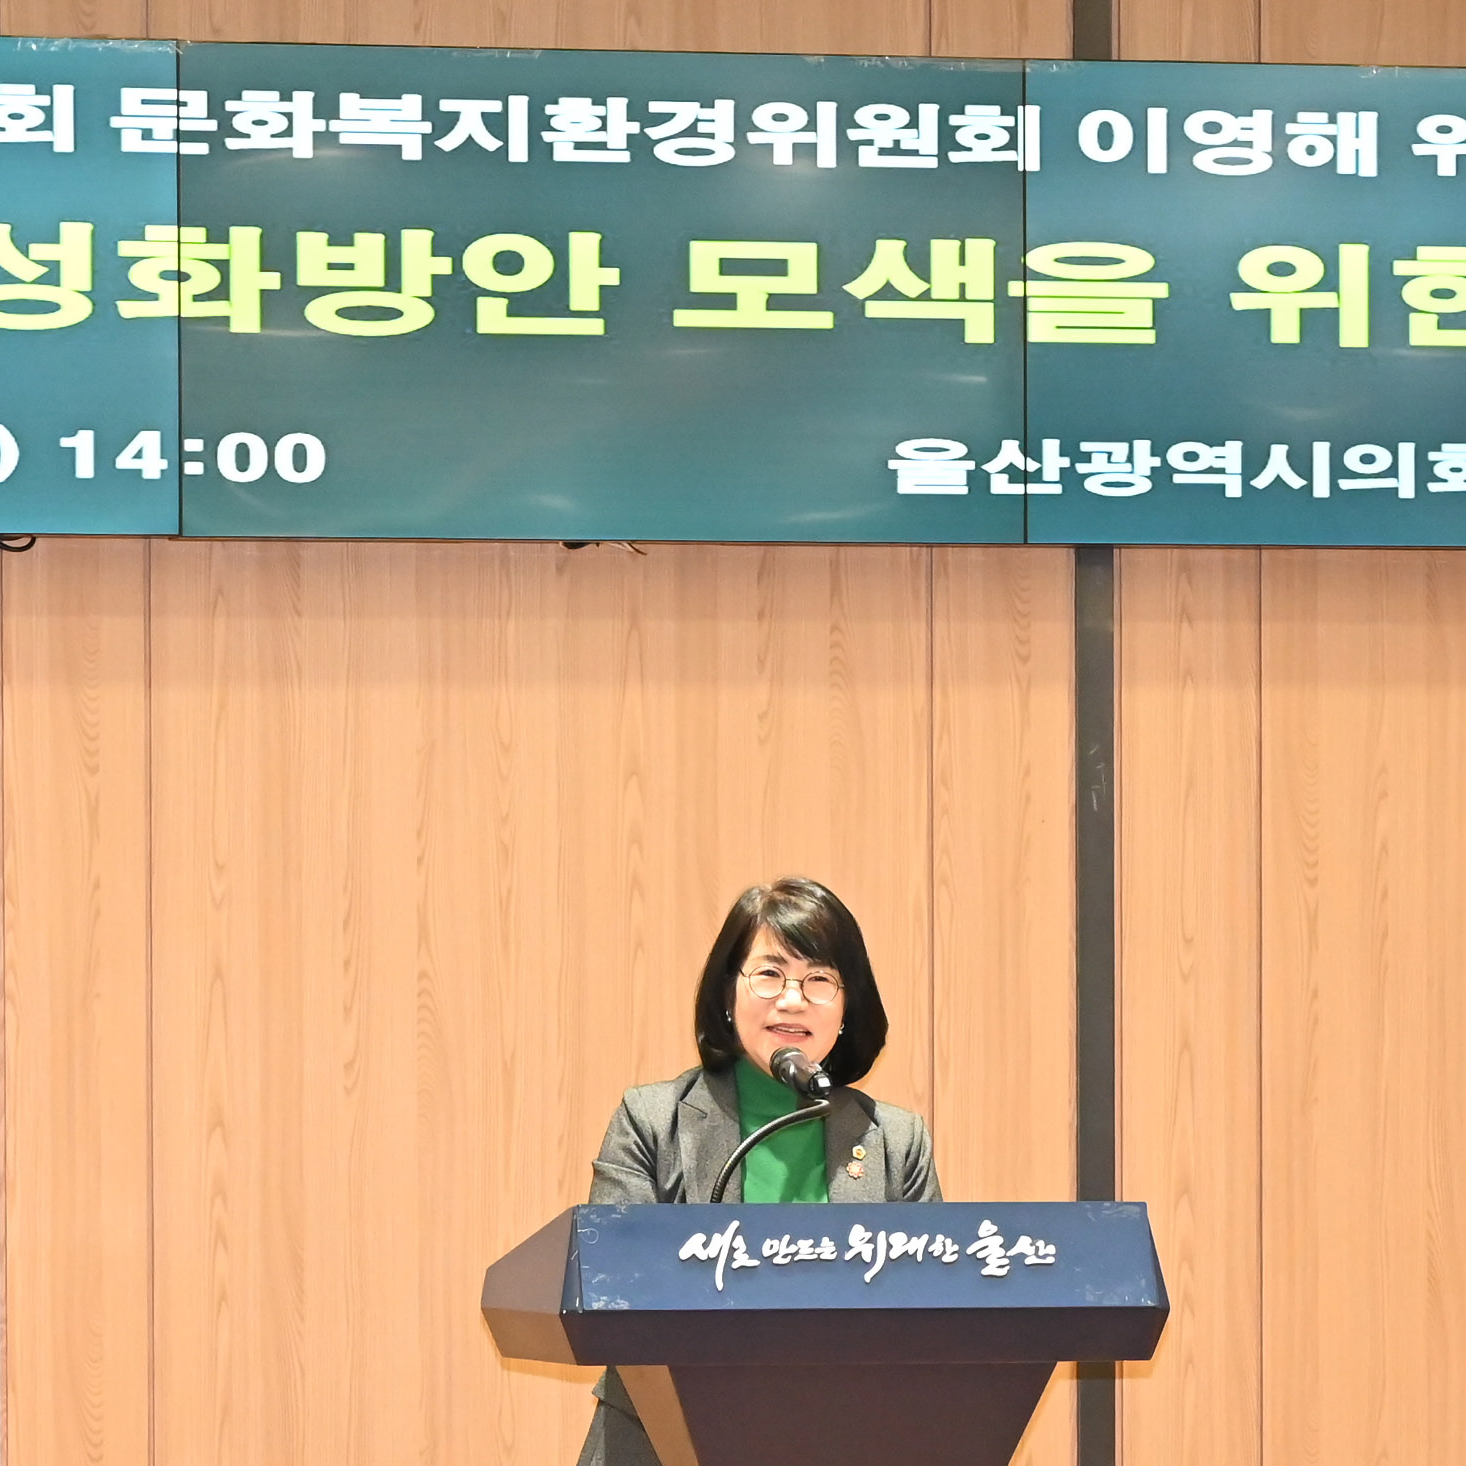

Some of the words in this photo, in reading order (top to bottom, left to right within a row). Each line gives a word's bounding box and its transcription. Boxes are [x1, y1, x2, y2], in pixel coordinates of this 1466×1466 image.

[110, 87, 1040, 172] 문화복지환경위원회
[1078, 107, 1378, 177] 이영해
[672, 237, 1170, 345] 모색을
[60, 429, 327, 483] 14:00
[678, 1220, 761, 1291] 새로
[761, 1234, 838, 1265] 만드는
[966, 1219, 1056, 1276] 울산
